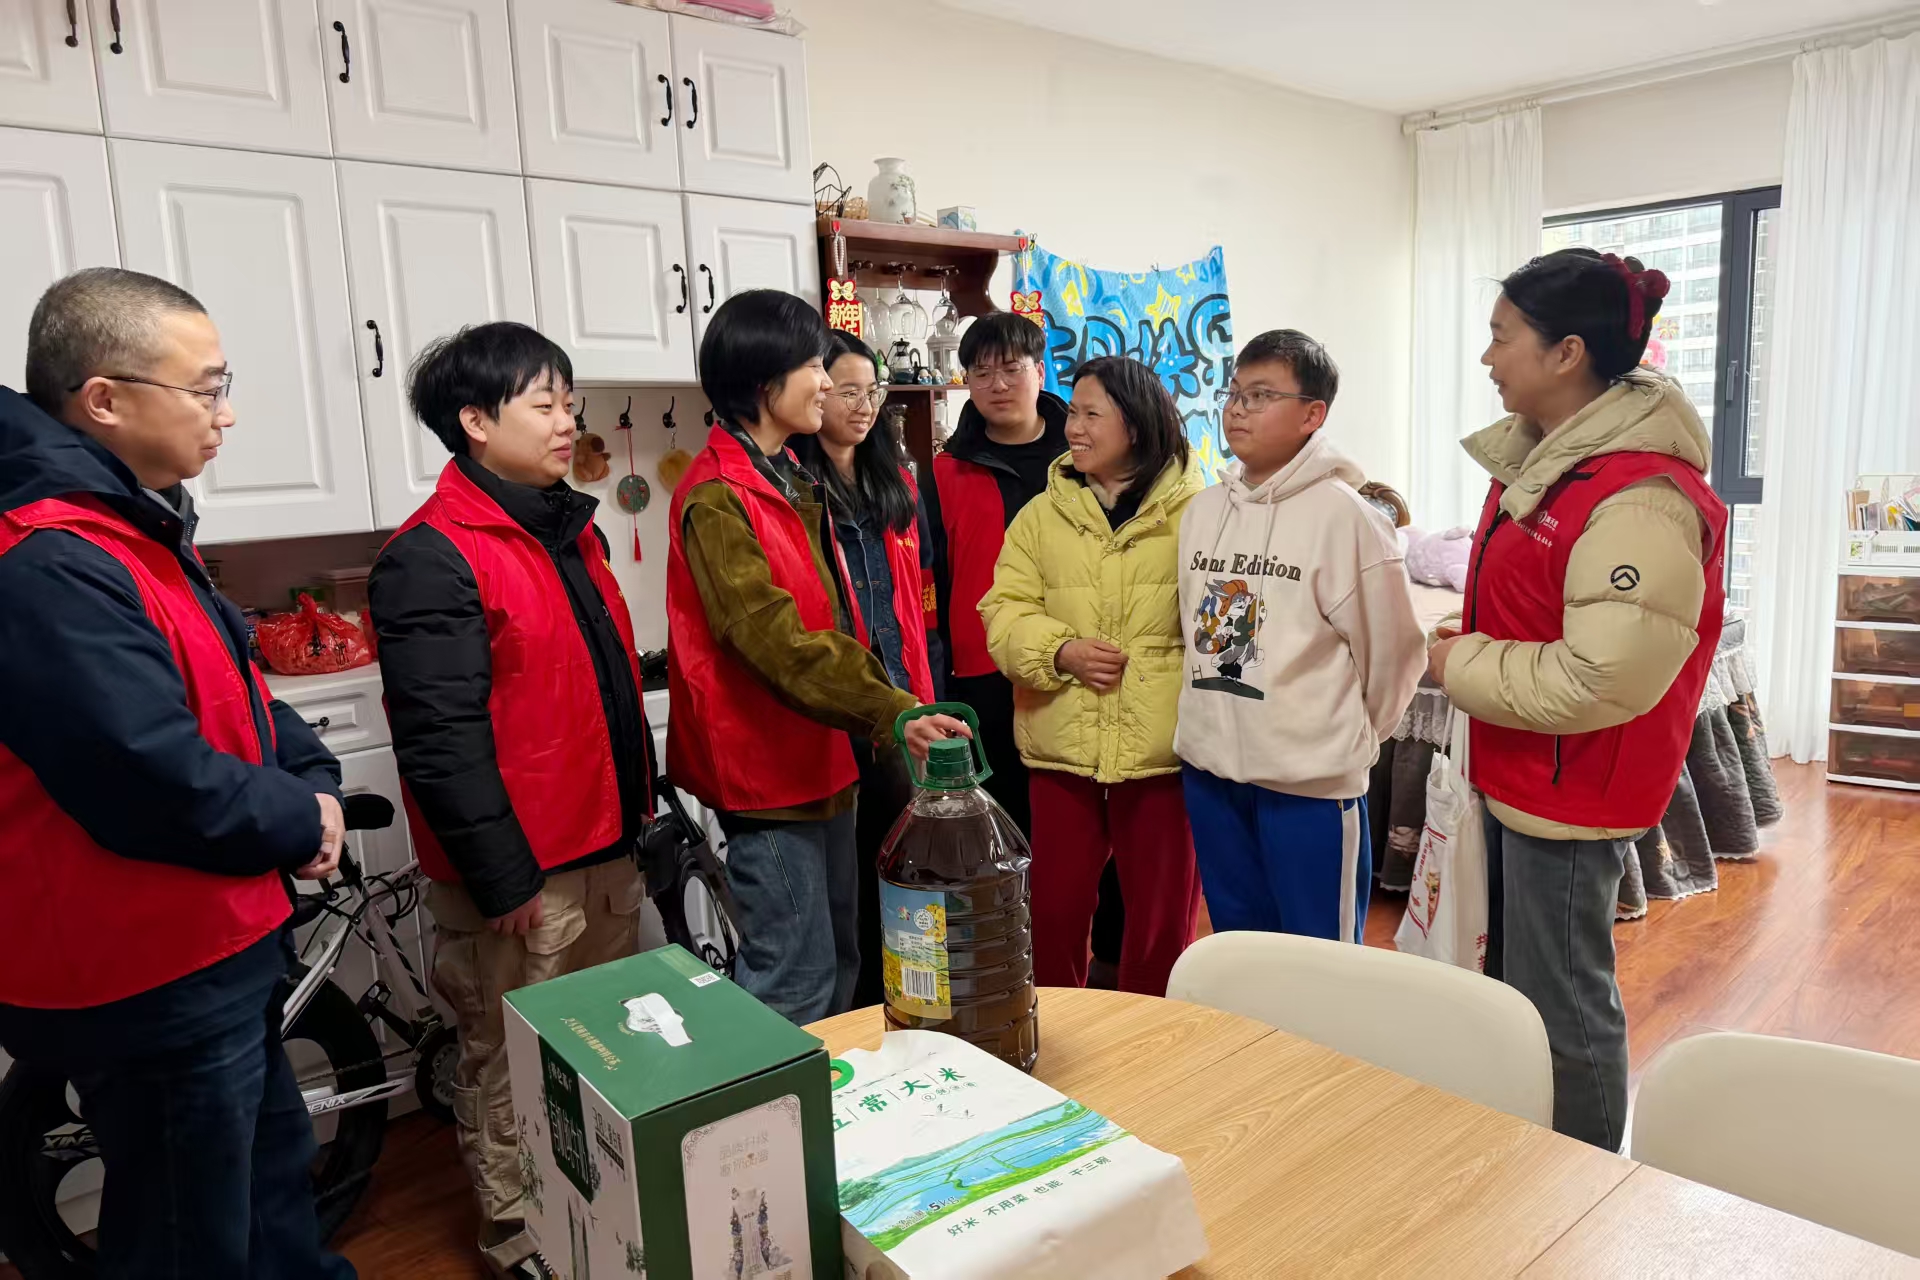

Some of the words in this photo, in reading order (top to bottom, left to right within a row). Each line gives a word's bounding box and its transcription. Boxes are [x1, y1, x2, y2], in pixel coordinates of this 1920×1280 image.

[1230, 553, 1301, 581] Edition
[947, 1216, 979, 1237] 好米
[983, 1193, 1030, 1217] 不用菜
[1033, 1180, 1064, 1196] 也能
